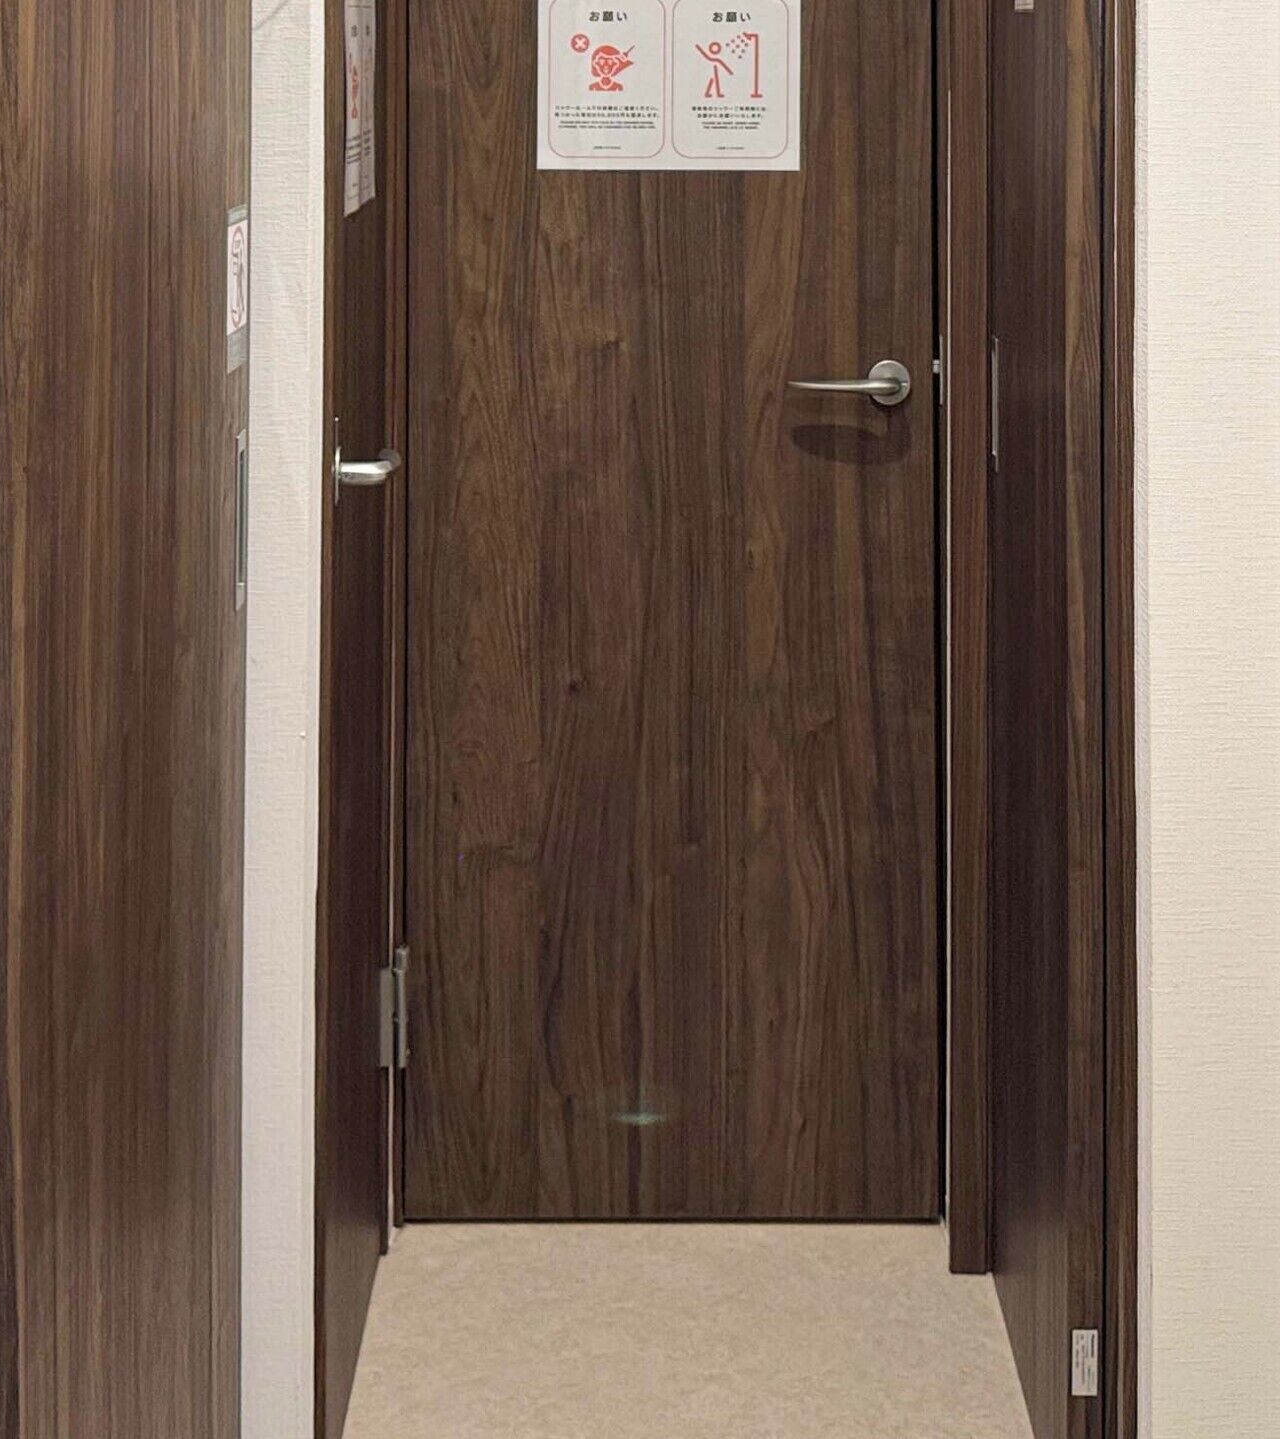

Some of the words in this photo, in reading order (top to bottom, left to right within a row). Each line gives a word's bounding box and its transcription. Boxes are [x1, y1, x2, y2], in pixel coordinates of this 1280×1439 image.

[588, 10, 628, 23] お願い
[711, 11, 753, 23] お願い
